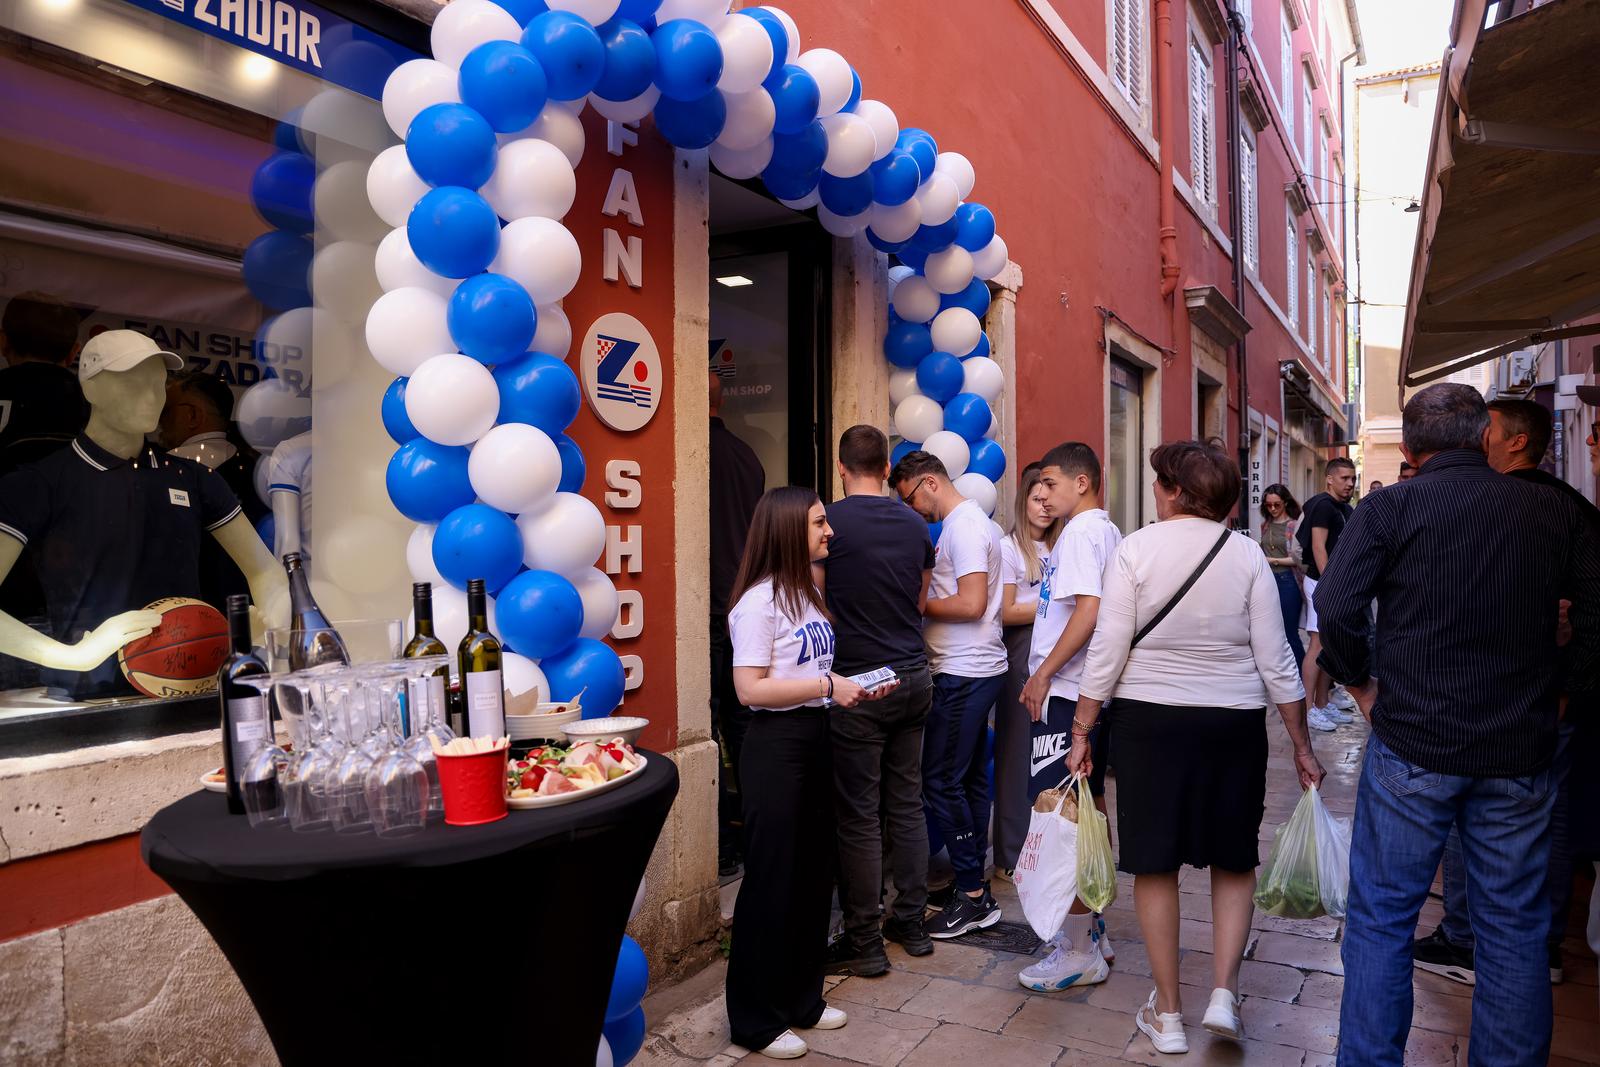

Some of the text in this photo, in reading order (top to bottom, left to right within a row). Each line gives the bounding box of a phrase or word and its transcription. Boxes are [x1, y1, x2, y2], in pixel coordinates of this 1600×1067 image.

[601, 118, 645, 289] FAN
[207, 332, 303, 366] SHOP
[188, 355, 304, 394] ZADAR
[740, 384, 772, 396] SHOP
[1252, 461, 1260, 504] URAR
[1032, 731, 1067, 759] NIKE
[956, 831, 973, 841] AIR
